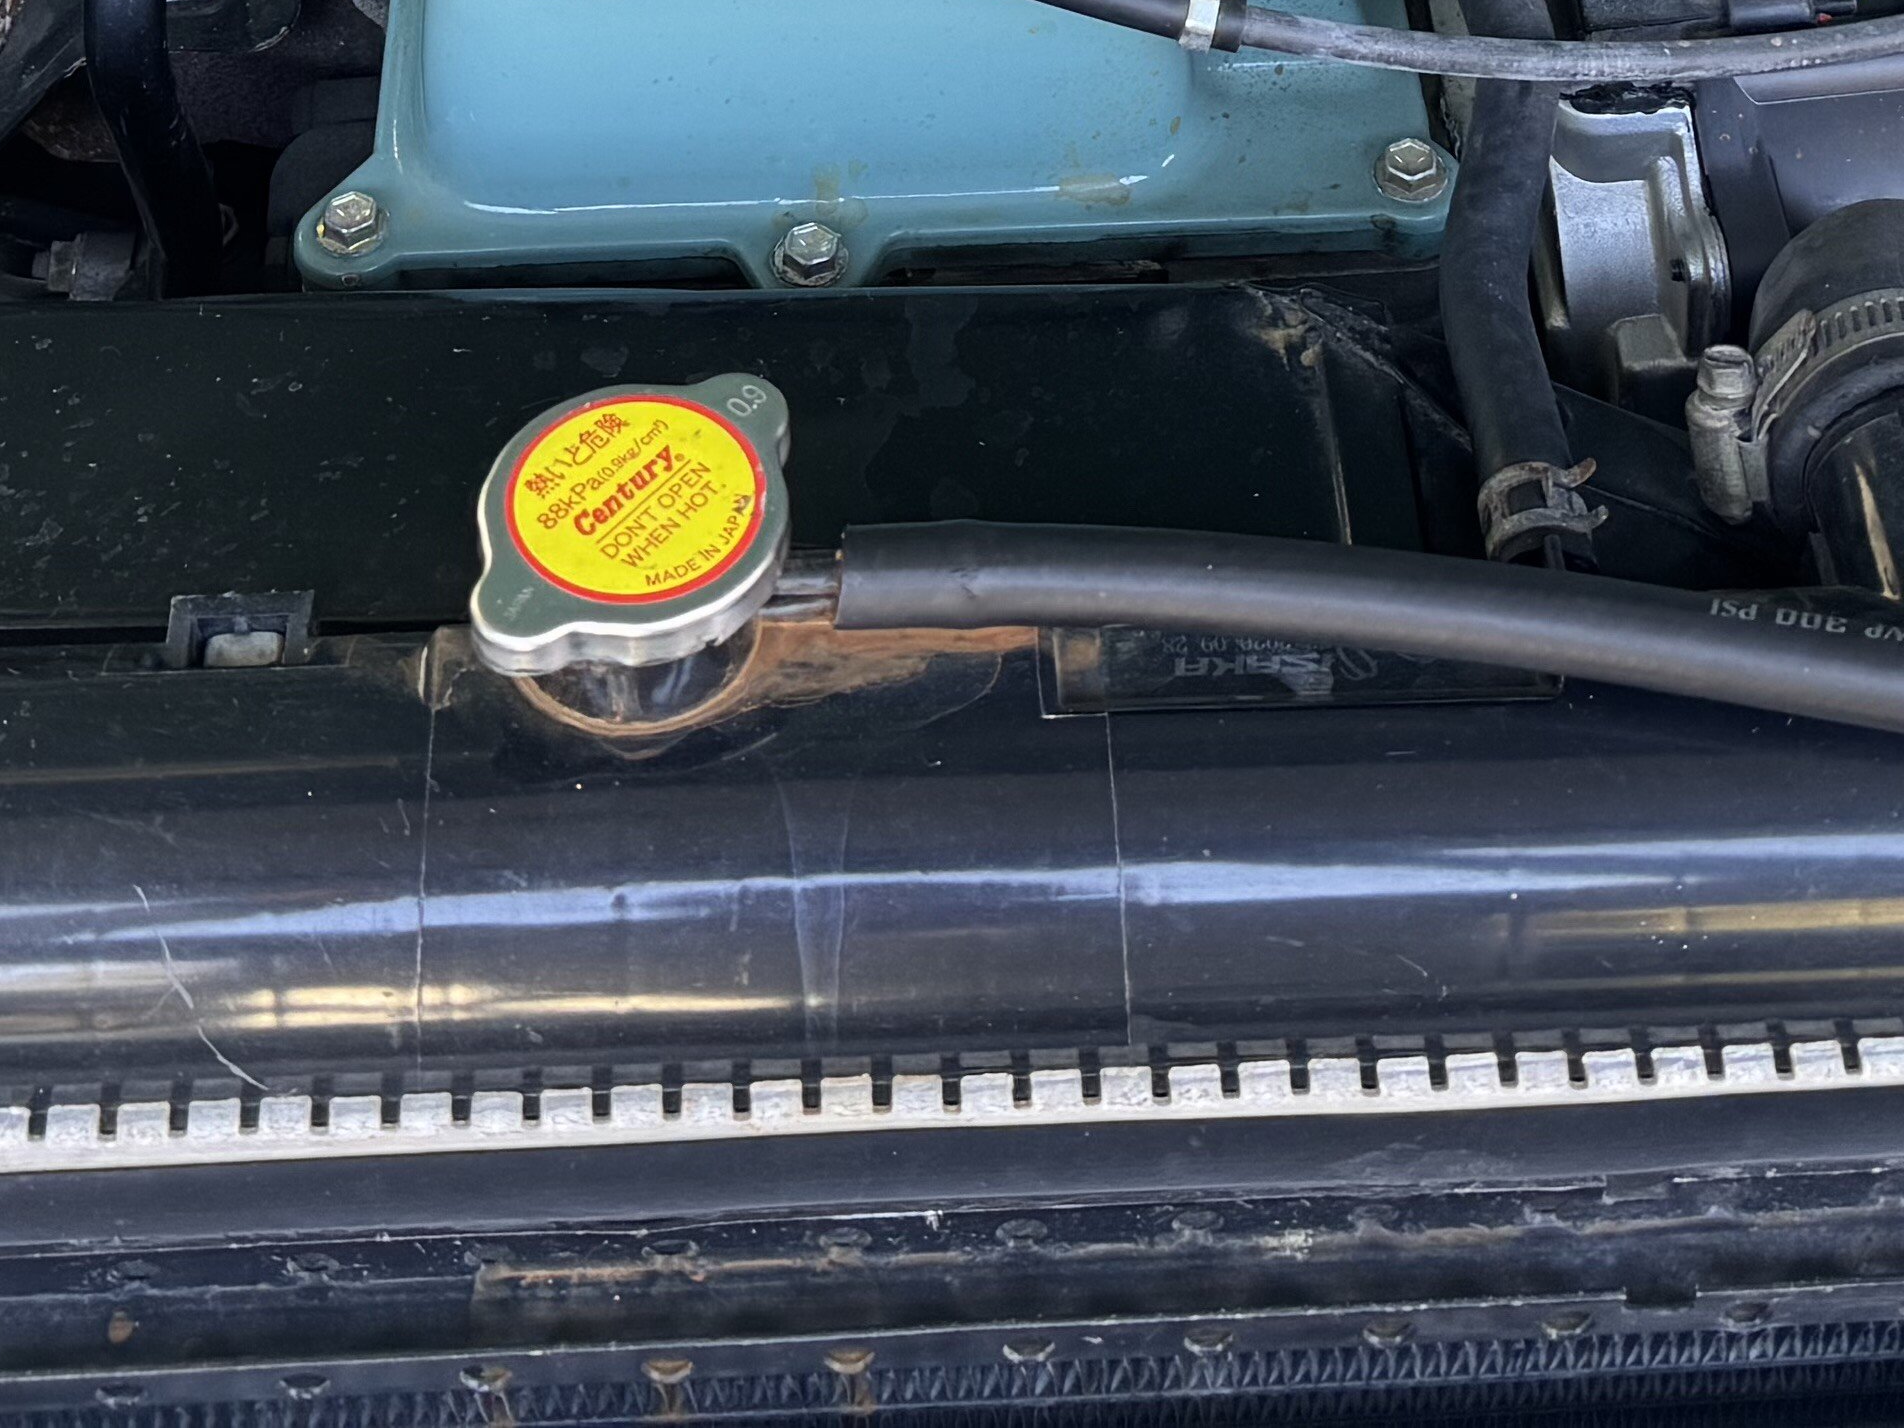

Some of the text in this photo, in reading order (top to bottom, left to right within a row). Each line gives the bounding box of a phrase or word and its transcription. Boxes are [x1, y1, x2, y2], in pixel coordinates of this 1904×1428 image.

[726, 384, 767, 417] 0.9
[524, 413, 630, 499] 熱いと危険
[574, 444, 674, 536] Century
[599, 461, 711, 560] DON'T OPEN
[621, 516, 681, 568] WHEN
[645, 560, 702, 587] MADE
[699, 545, 722, 562] IN
[1709, 597, 1758, 621] PSI
